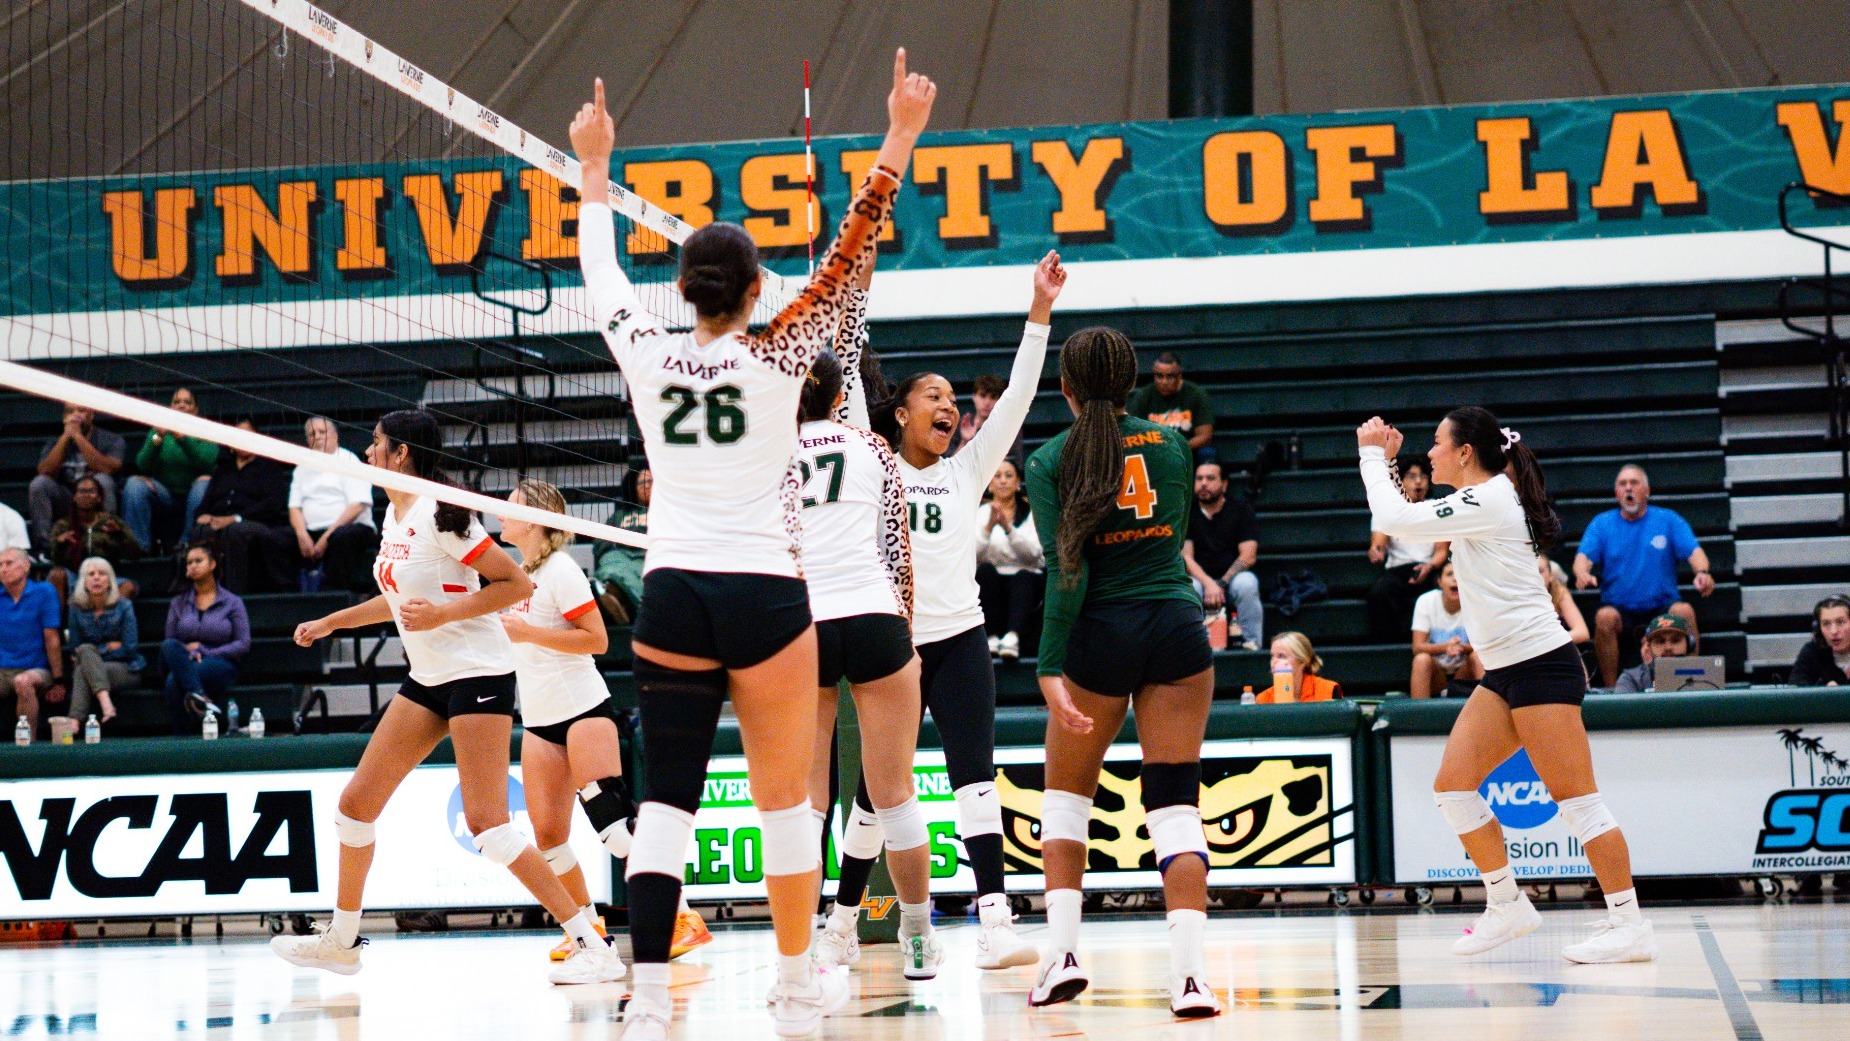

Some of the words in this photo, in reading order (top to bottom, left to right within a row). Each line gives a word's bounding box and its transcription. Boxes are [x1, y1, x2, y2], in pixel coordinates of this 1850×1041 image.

[1203, 124, 1400, 232] OF
[1476, 109, 1702, 219] LA
[659, 382, 749, 448] 26
[800, 434, 846, 448] ERNE
[1115, 453, 1158, 520] 4
[906, 501, 943, 535] 18
[1433, 500, 1455, 519] 19
[1095, 524, 1173, 546] LEOPARDS
[378, 561, 400, 594] 14
[0, 790, 319, 900] NCAA
[1560, 865, 1595, 874] DEDI
